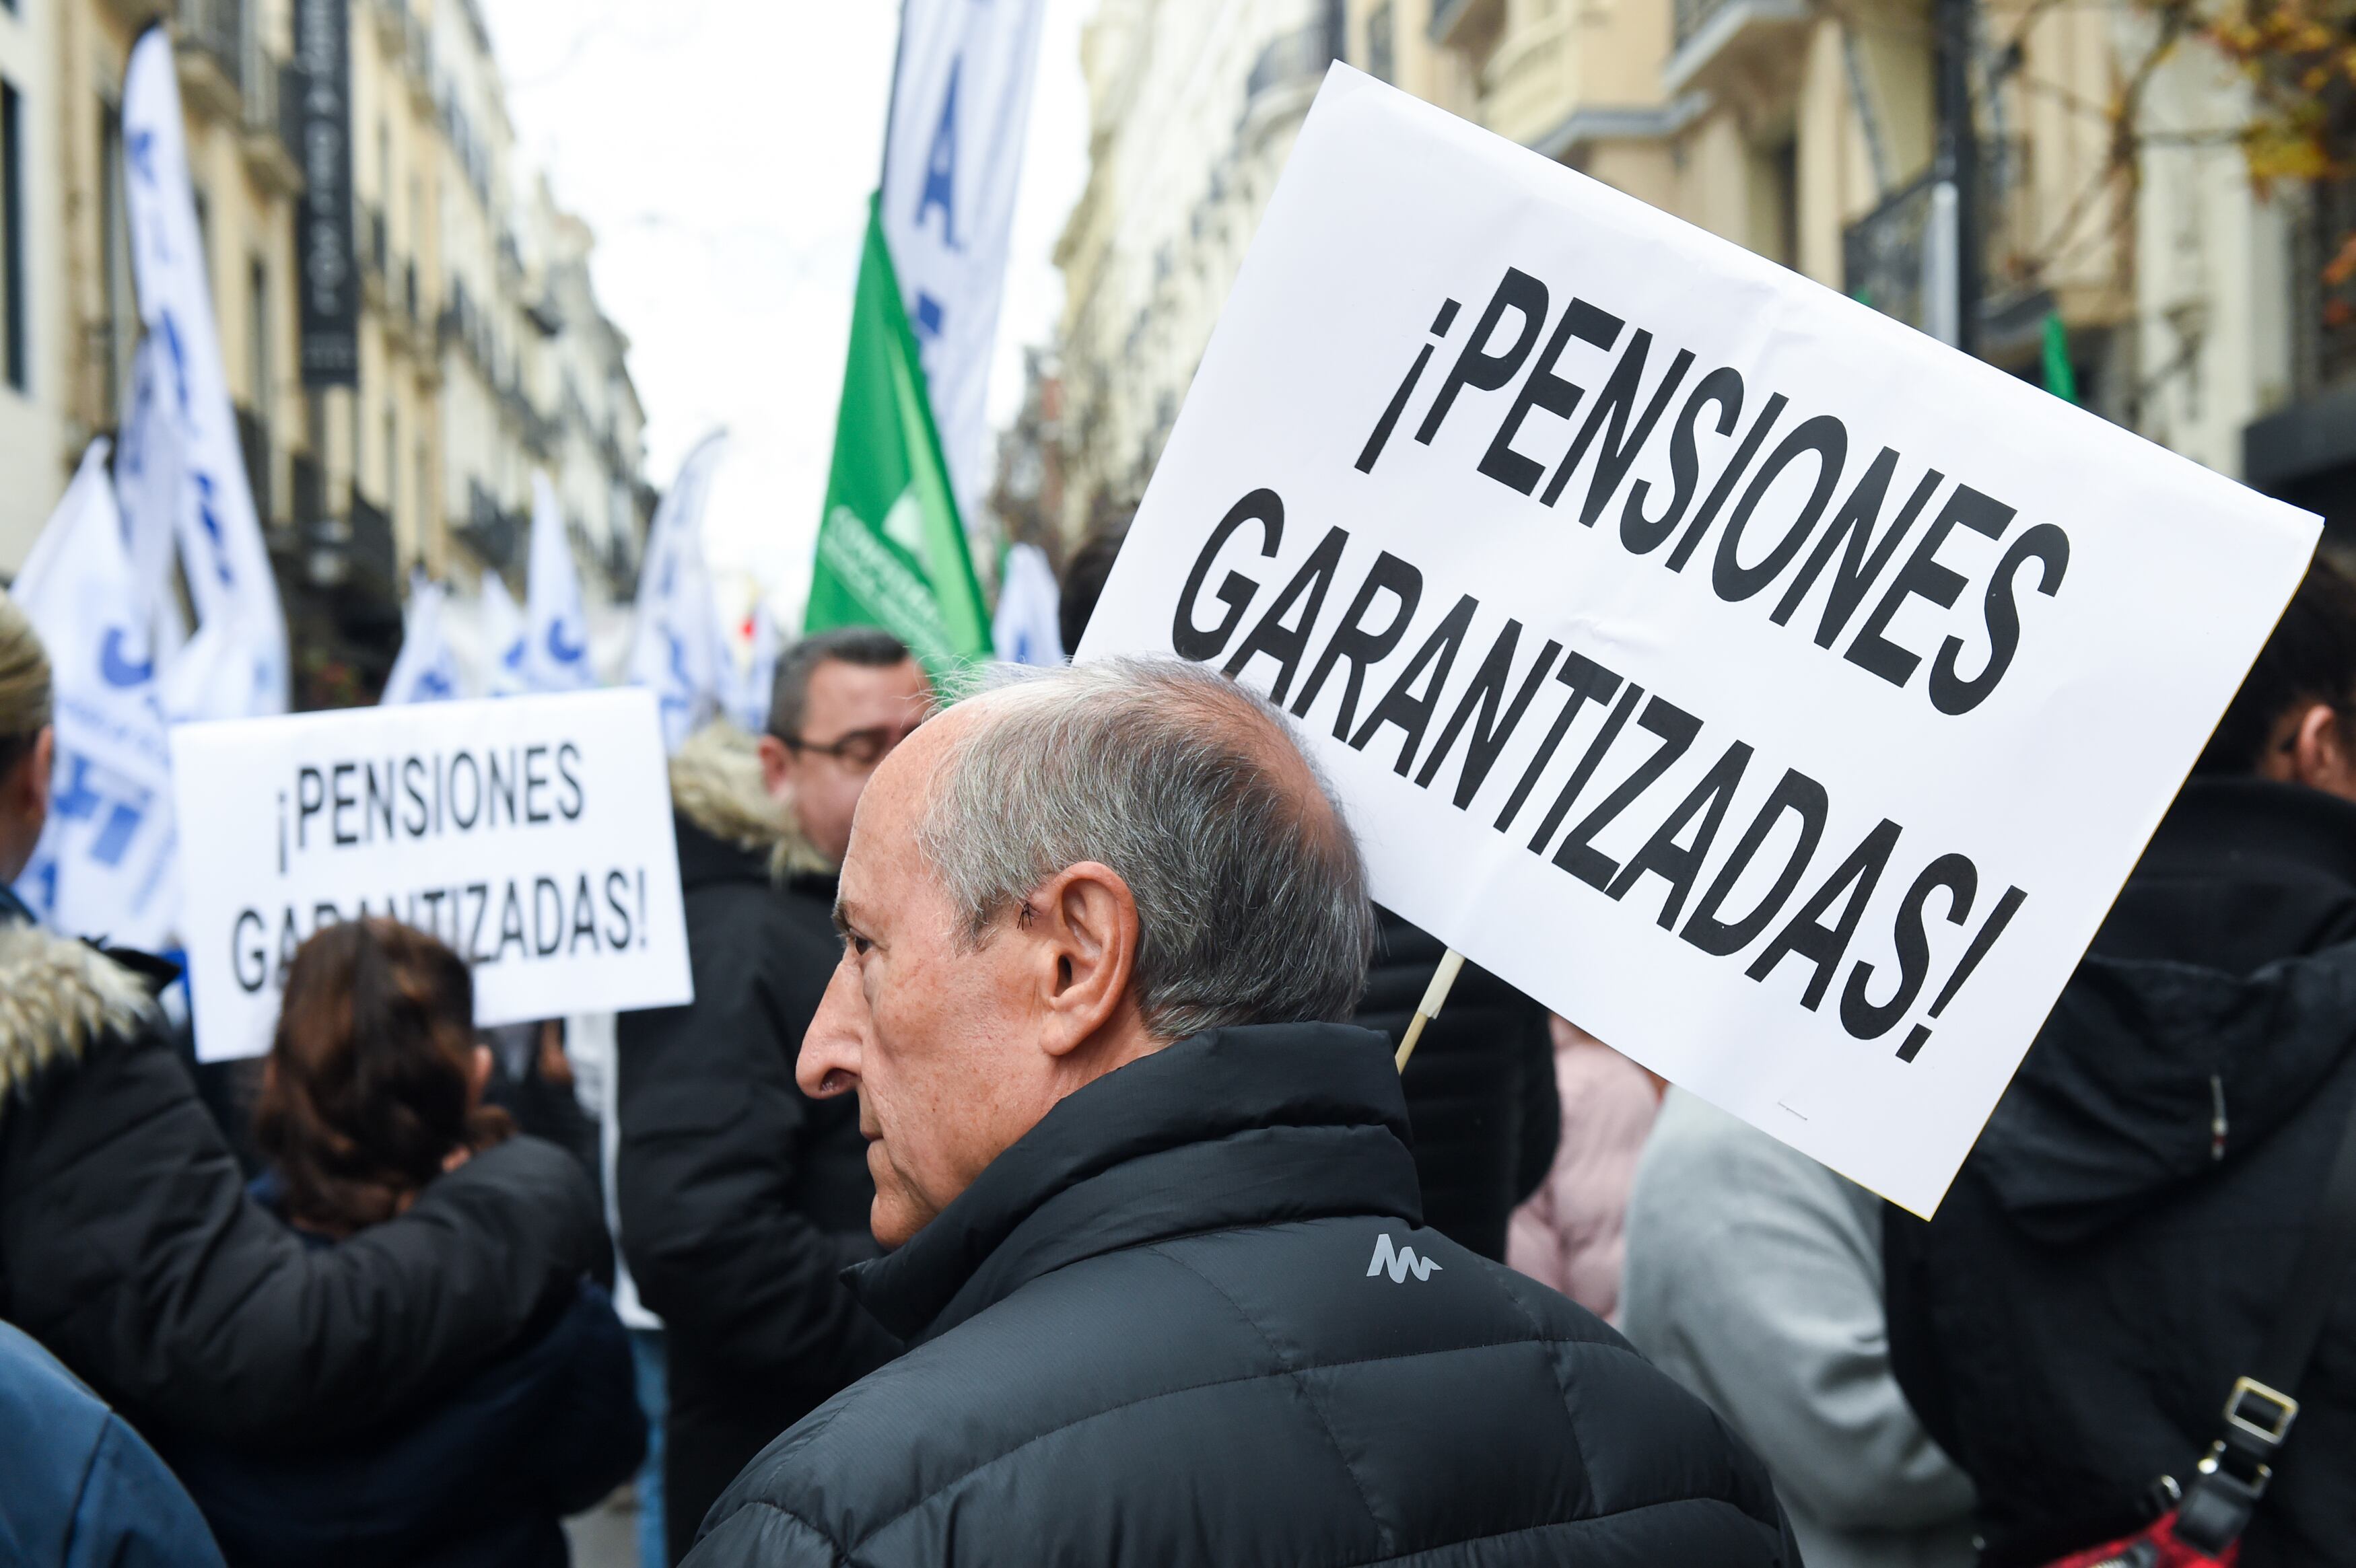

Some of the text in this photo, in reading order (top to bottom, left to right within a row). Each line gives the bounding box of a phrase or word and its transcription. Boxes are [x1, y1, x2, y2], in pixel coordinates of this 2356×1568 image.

[1354, 267, 2069, 715] ¡PENSIONES
[277, 742, 583, 874] ¡PENSIONES
[1173, 489, 2028, 1063] GARANTIZADAS!
[233, 869, 647, 995] GATIZADAS!
